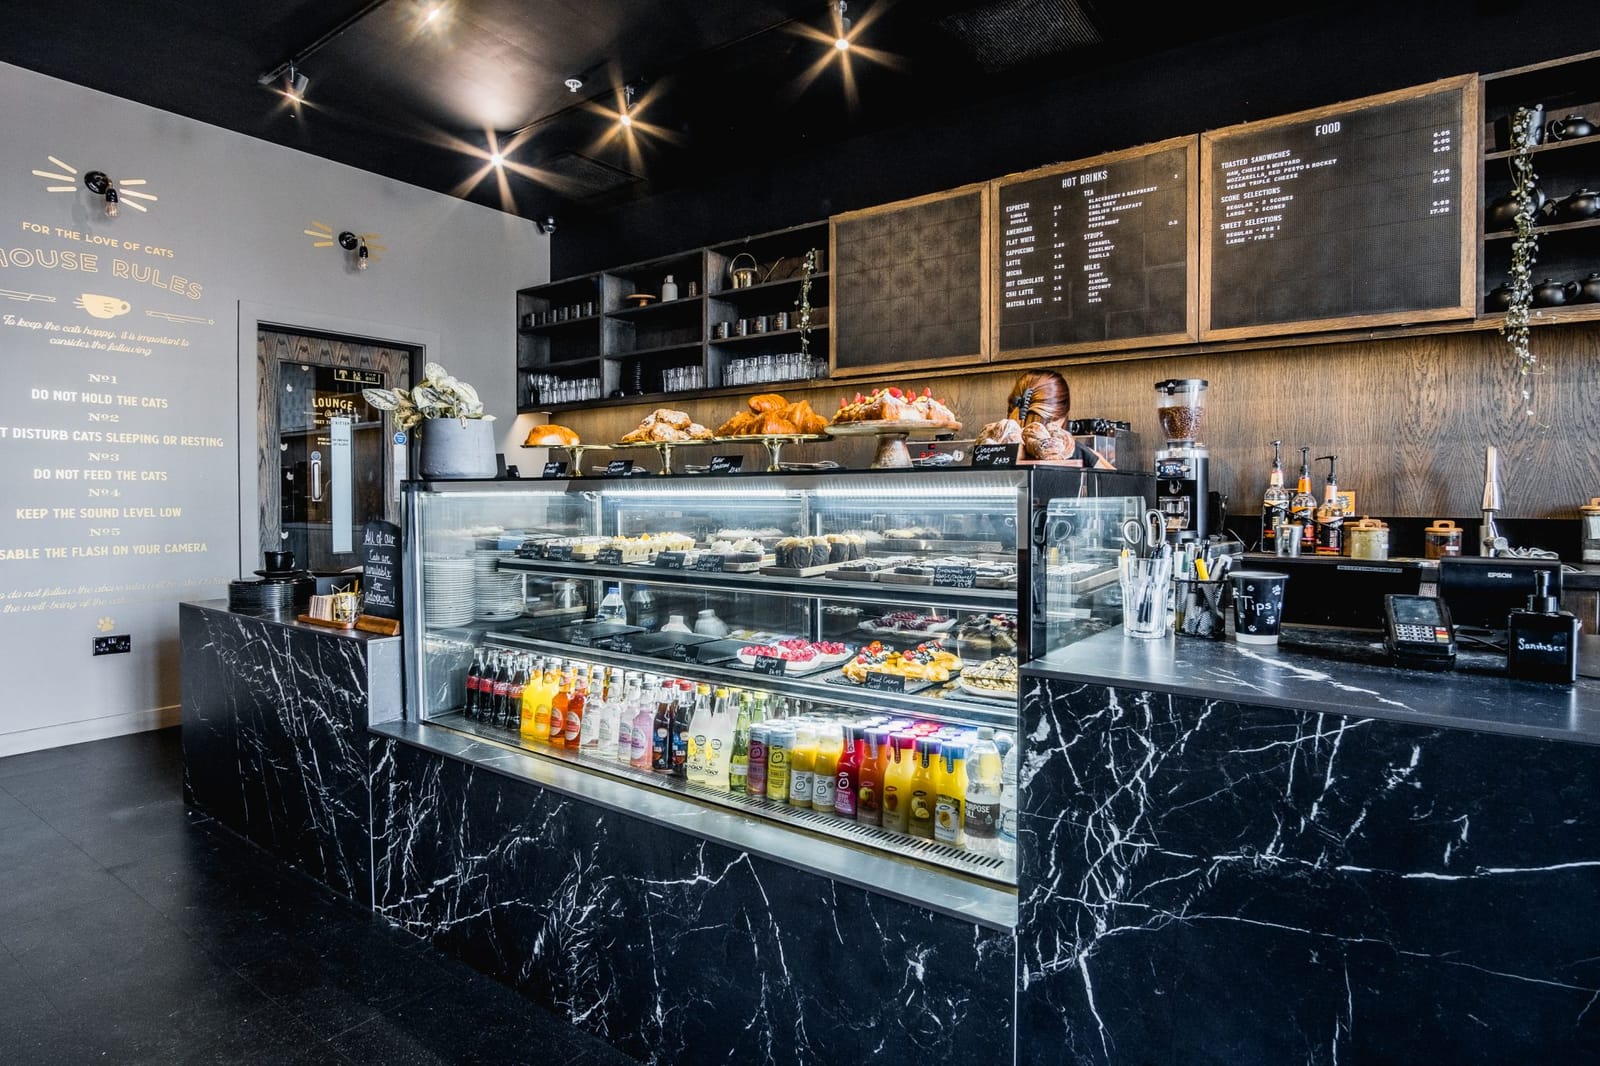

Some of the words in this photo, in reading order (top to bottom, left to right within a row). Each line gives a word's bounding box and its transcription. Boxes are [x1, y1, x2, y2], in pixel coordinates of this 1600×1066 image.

[1315, 121, 1341, 136] FOOD
[1221, 158, 1248, 169] TOASTED
[1251, 149, 1291, 163] SANDWICHES
[1241, 164, 1264, 174] CHEESE
[1272, 158, 1301, 168] MUSTARD
[1284, 165, 1304, 173] PESTO
[1312, 158, 1337, 168] ROCKET
[1062, 177, 1077, 188] HOT
[1080, 170, 1108, 185] DRINKS
[1274, 173, 1298, 182] CHEESE
[1221, 193, 1240, 203] SCONE
[1243, 187, 1281, 199] SELECTIONS
[1226, 202, 1253, 211] REGULAR
[1270, 195, 1294, 203] SCONES
[1262, 203, 1286, 212] SCONES
[1220, 221, 1241, 230] SWEET
[1245, 215, 1282, 226] SELECTIONS
[22, 221, 50, 235] FOR
[55, 228, 80, 240] THE
[86, 234, 118, 248] LOVE
[123, 241, 140, 251] OF
[145, 246, 174, 258] CATS
[1226, 229, 1253, 237] REGULAR
[1006, 259, 1021, 267] LATTE
[112, 258, 203, 300] RULES
[3, 314, 16, 325] To
[17, 318, 42, 330] keep
[44, 321, 60, 331] the
[62, 325, 81, 334] cats
[137, 333, 181, 346] important
[49, 337, 90, 349] consider
[91, 340, 106, 350] the
[107, 341, 152, 357] following
[31, 388, 49, 400] DO
[53, 390, 77, 402] NOT
[82, 392, 112, 405] HOLD
[117, 395, 138, 406] THE
[141, 397, 168, 408] CATS
[312, 398, 353, 411] LOUNGE
[13, 428, 68, 440] DISTURB
[73, 431, 102, 442] CATS
[106, 432, 159, 444] SLEEPING
[163, 435, 177, 445] OR
[181, 436, 224, 447] RESTING
[33, 469, 50, 479] DO
[56, 469, 79, 479] NOT
[84, 470, 112, 480] FEED
[116, 470, 137, 480] THE
[141, 471, 167, 481] CATS
[16, 508, 48, 519] KEEP
[53, 508, 75, 519] THE
[80, 508, 119, 519] SOUND
[123, 508, 156, 518] LEVEL
[160, 507, 182, 517] LOW
[45, 548, 67, 558] THE
[72, 546, 109, 557] FLASH
[113, 545, 129, 556] ON
[133, 544, 160, 555] YOUR
[164, 543, 207, 553] CAMERA
[1240, 596, 1272, 616] Tips
